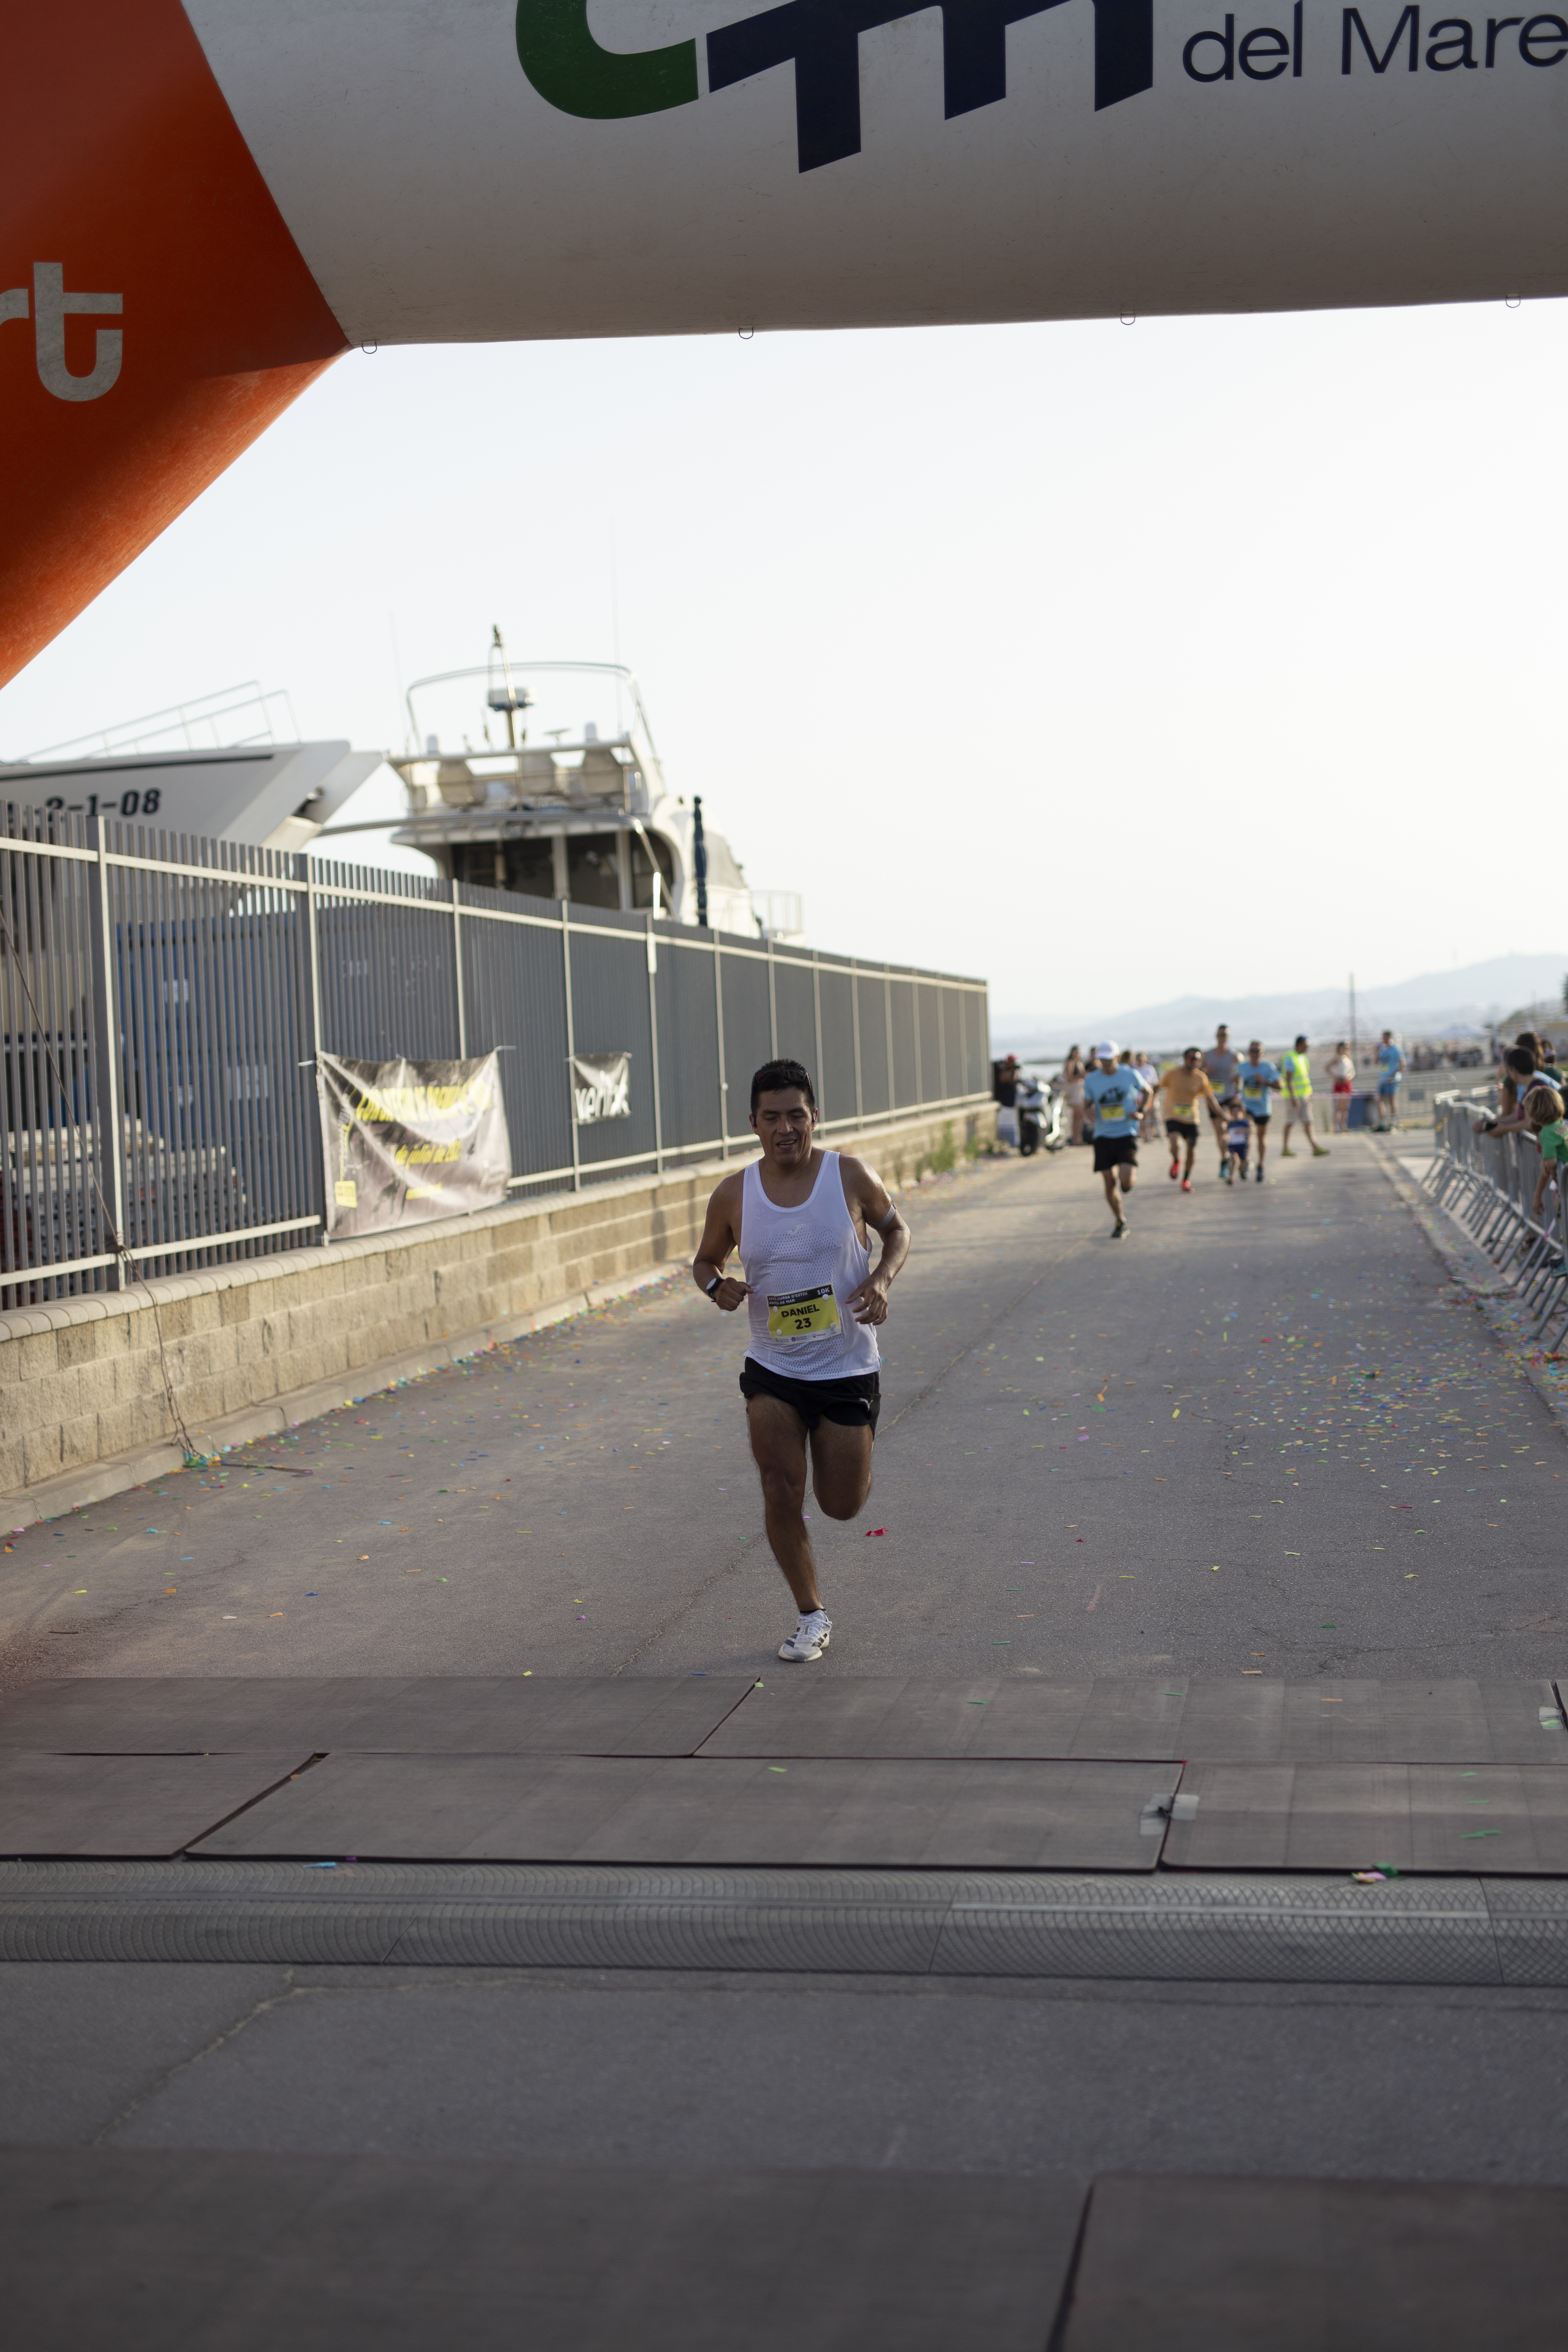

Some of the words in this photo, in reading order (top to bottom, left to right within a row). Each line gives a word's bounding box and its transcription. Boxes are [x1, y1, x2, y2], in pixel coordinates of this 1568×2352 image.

[1182, 0, 1303, 83] del
[817, 1287, 830, 1295] 10K
[781, 1304, 820, 1318] DANIEL
[794, 1317, 812, 1330] 23
